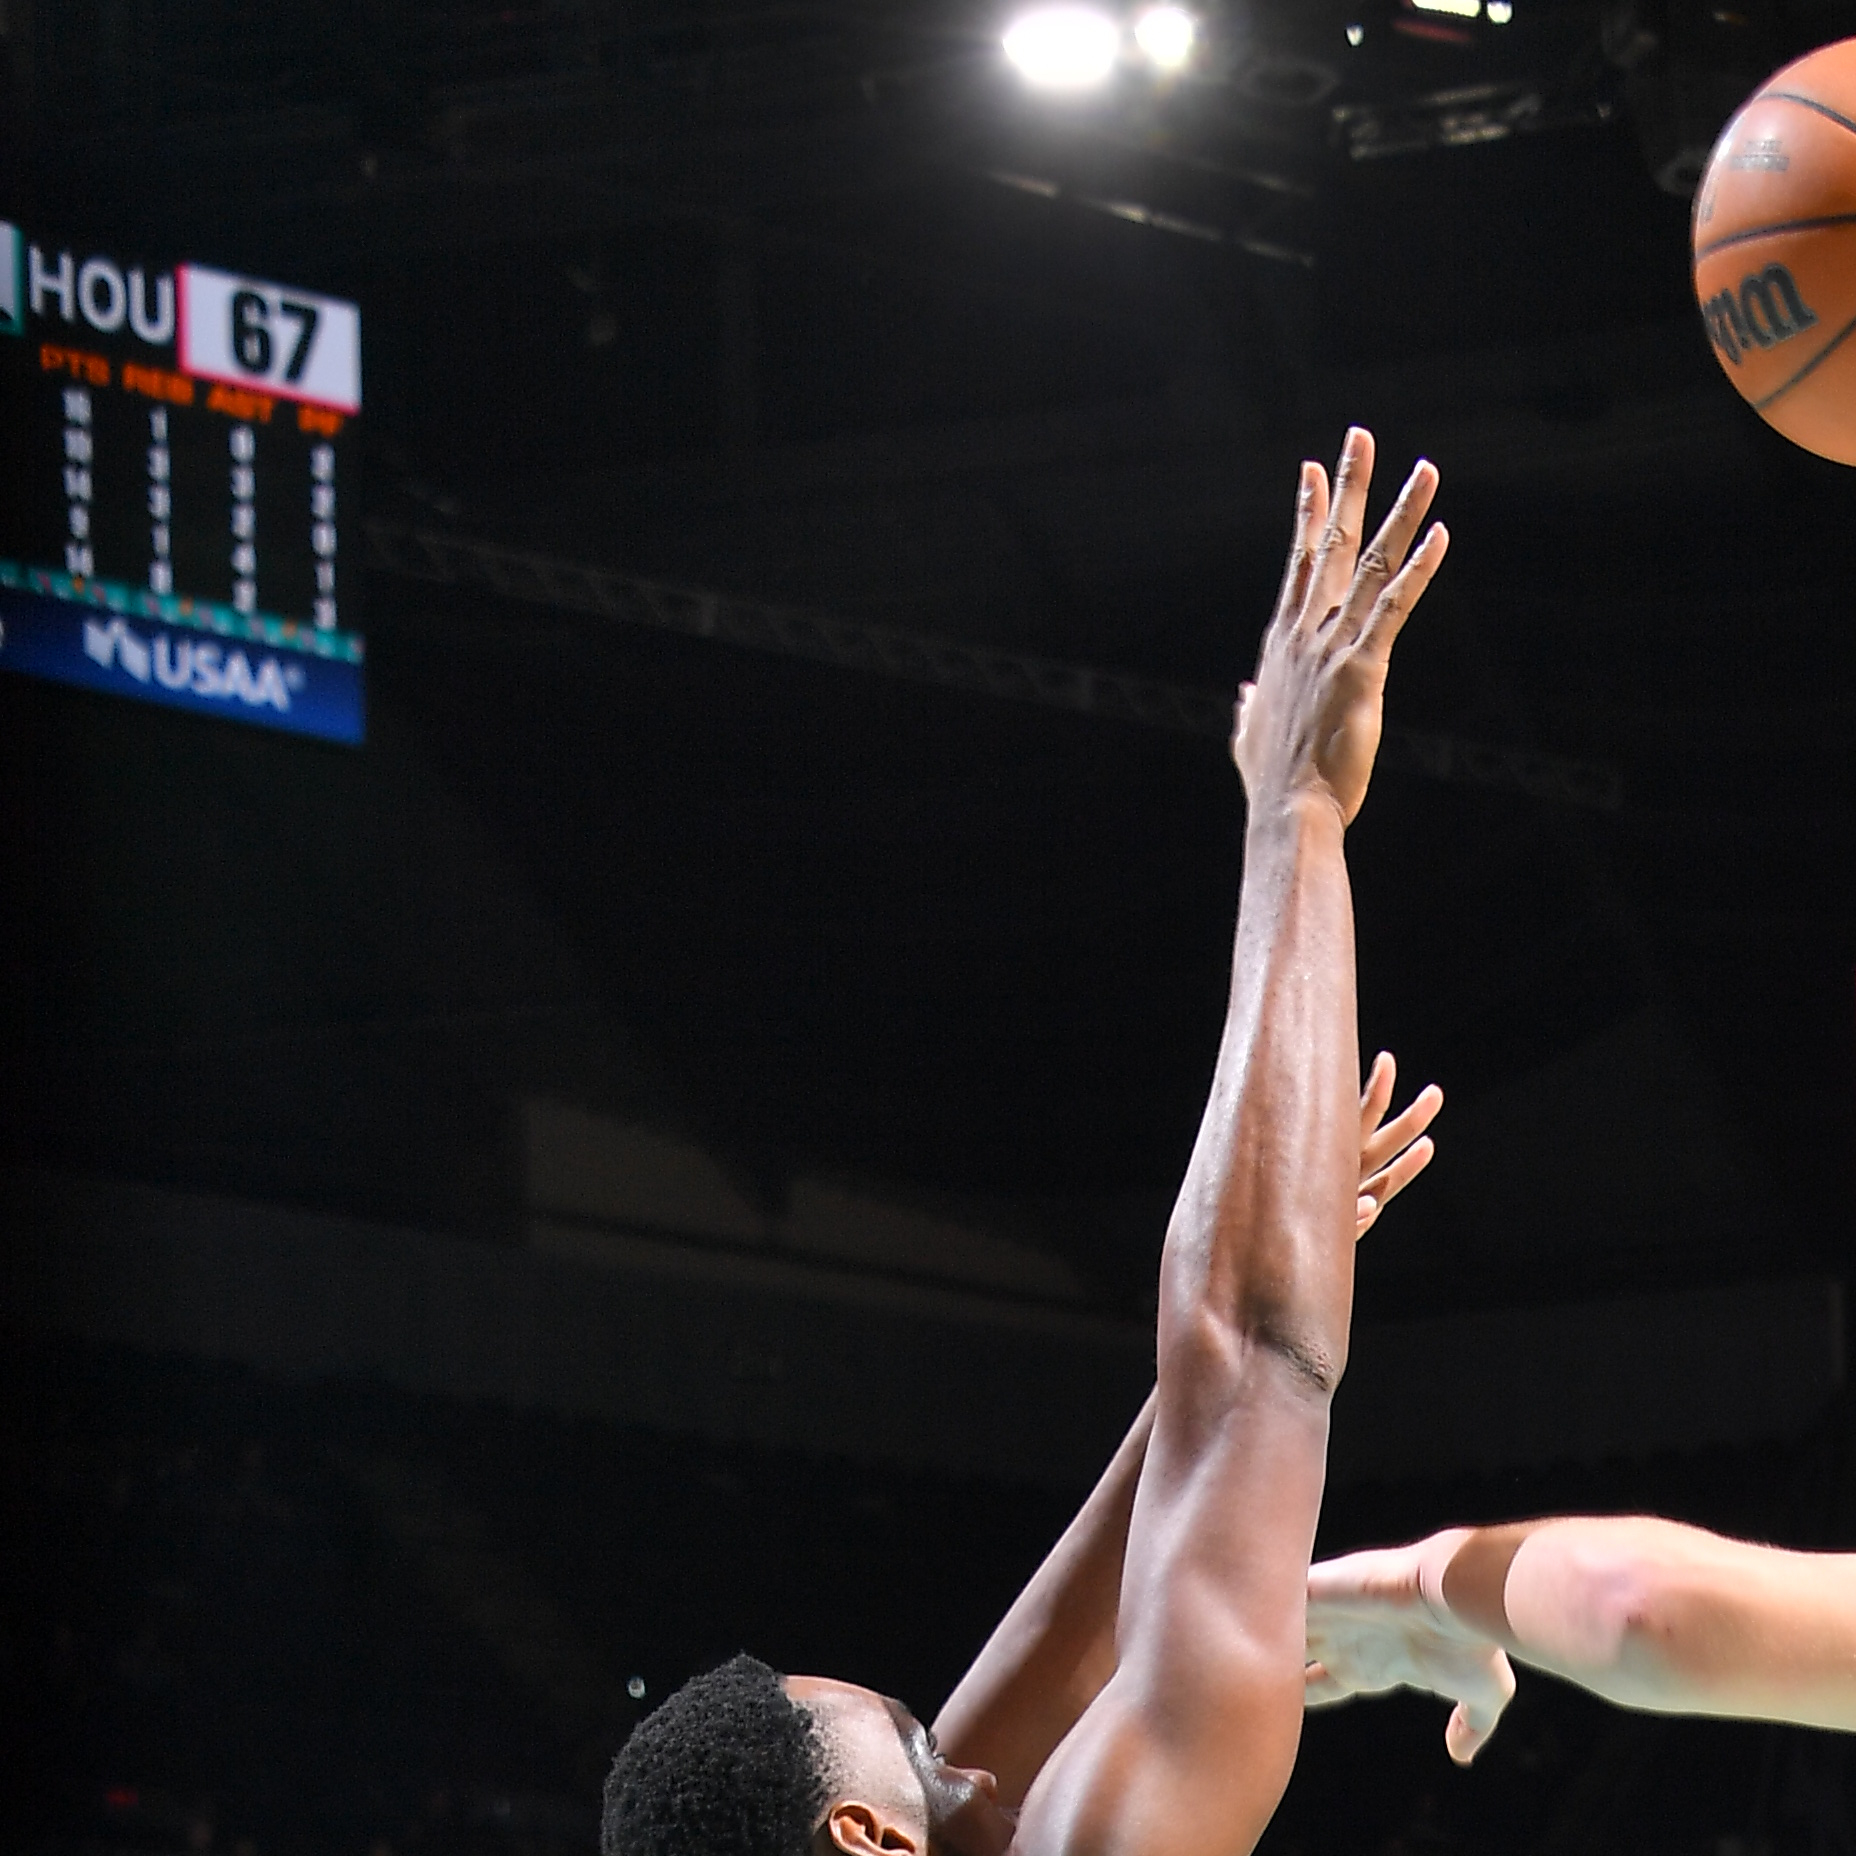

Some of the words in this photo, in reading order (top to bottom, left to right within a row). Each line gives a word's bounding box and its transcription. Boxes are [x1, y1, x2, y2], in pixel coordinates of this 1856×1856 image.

[28, 243, 176, 345] HOU
[229, 288, 324, 384] 67
[151, 631, 291, 713] USAA
